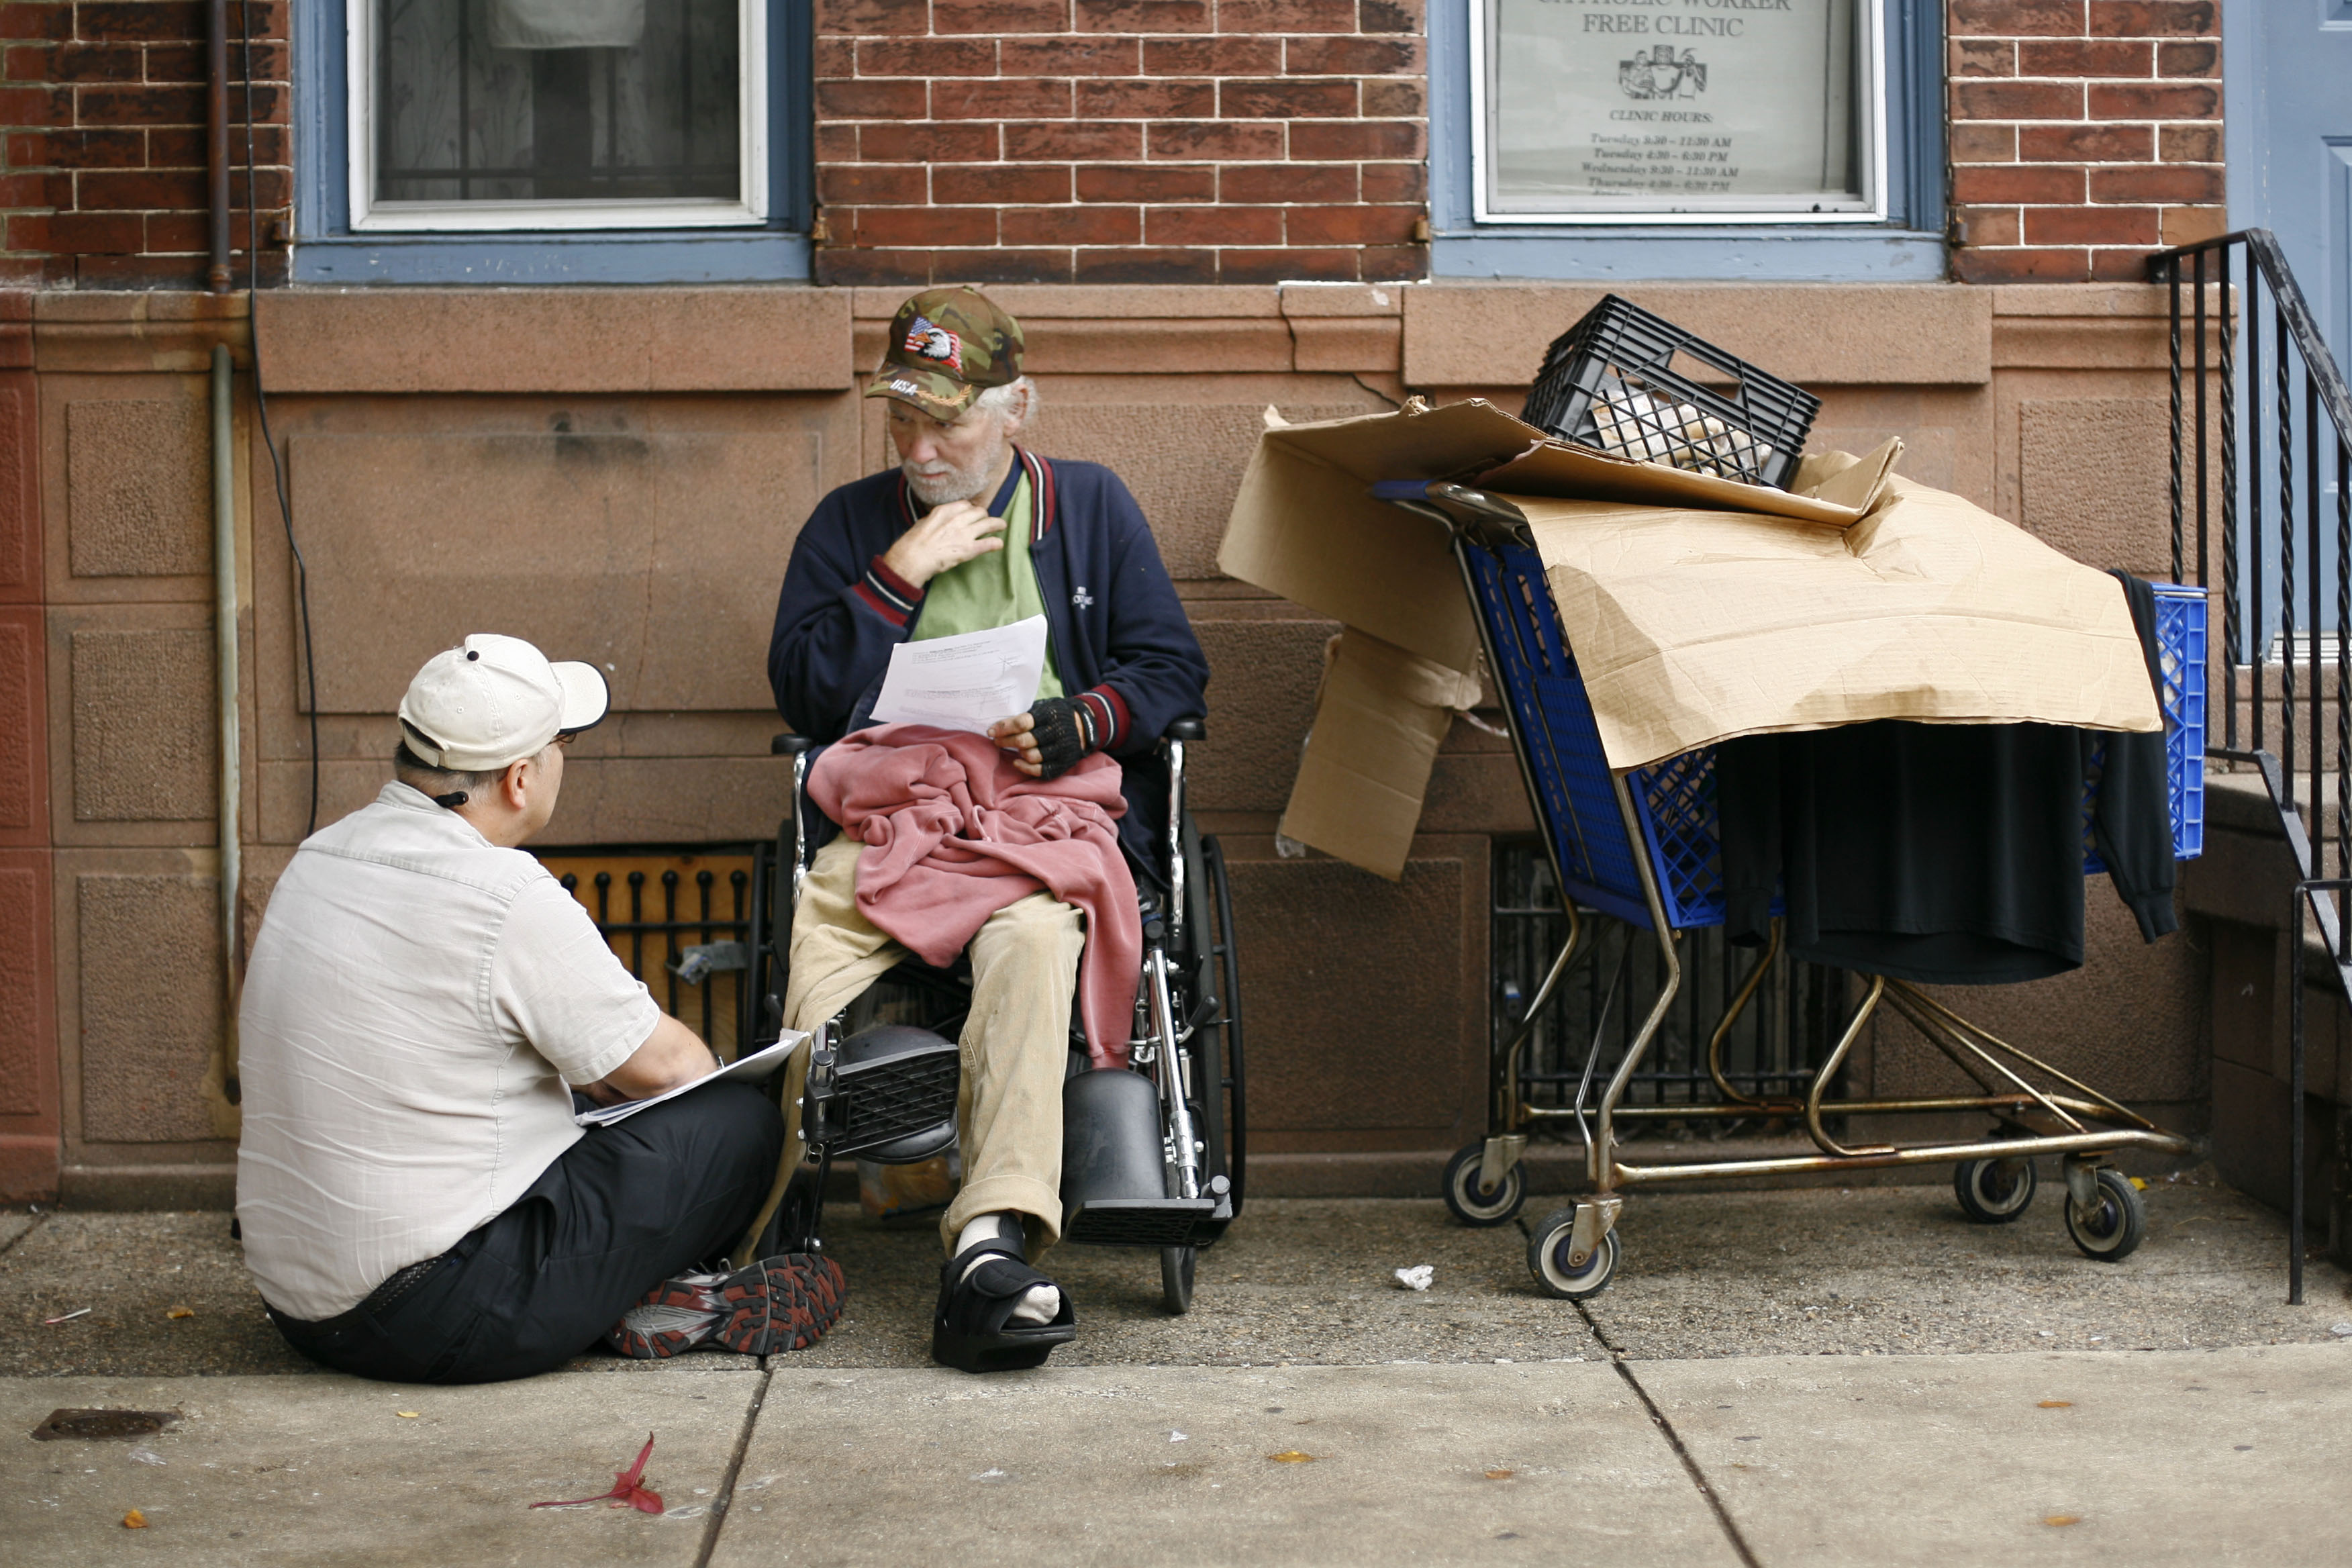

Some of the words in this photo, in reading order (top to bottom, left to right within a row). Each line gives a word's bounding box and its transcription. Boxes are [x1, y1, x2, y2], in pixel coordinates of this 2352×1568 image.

[1583, 13, 1649, 33] FREE
[1655, 16, 1745, 36] CLINIC
[1610, 110, 1659, 122] CLINIC
[1661, 111, 1714, 124] HOURS:
[1591, 133, 1639, 147] Tuesday
[1712, 137, 1732, 148] AM
[1594, 148, 1643, 162] Tuesday
[1708, 151, 1728, 162] PM
[1581, 162, 1647, 177] Wednesday
[1719, 166, 1739, 177] AM
[1588, 177, 1645, 189] Thursday
[1709, 181, 1730, 192] PM
[889, 379, 918, 396] USA
